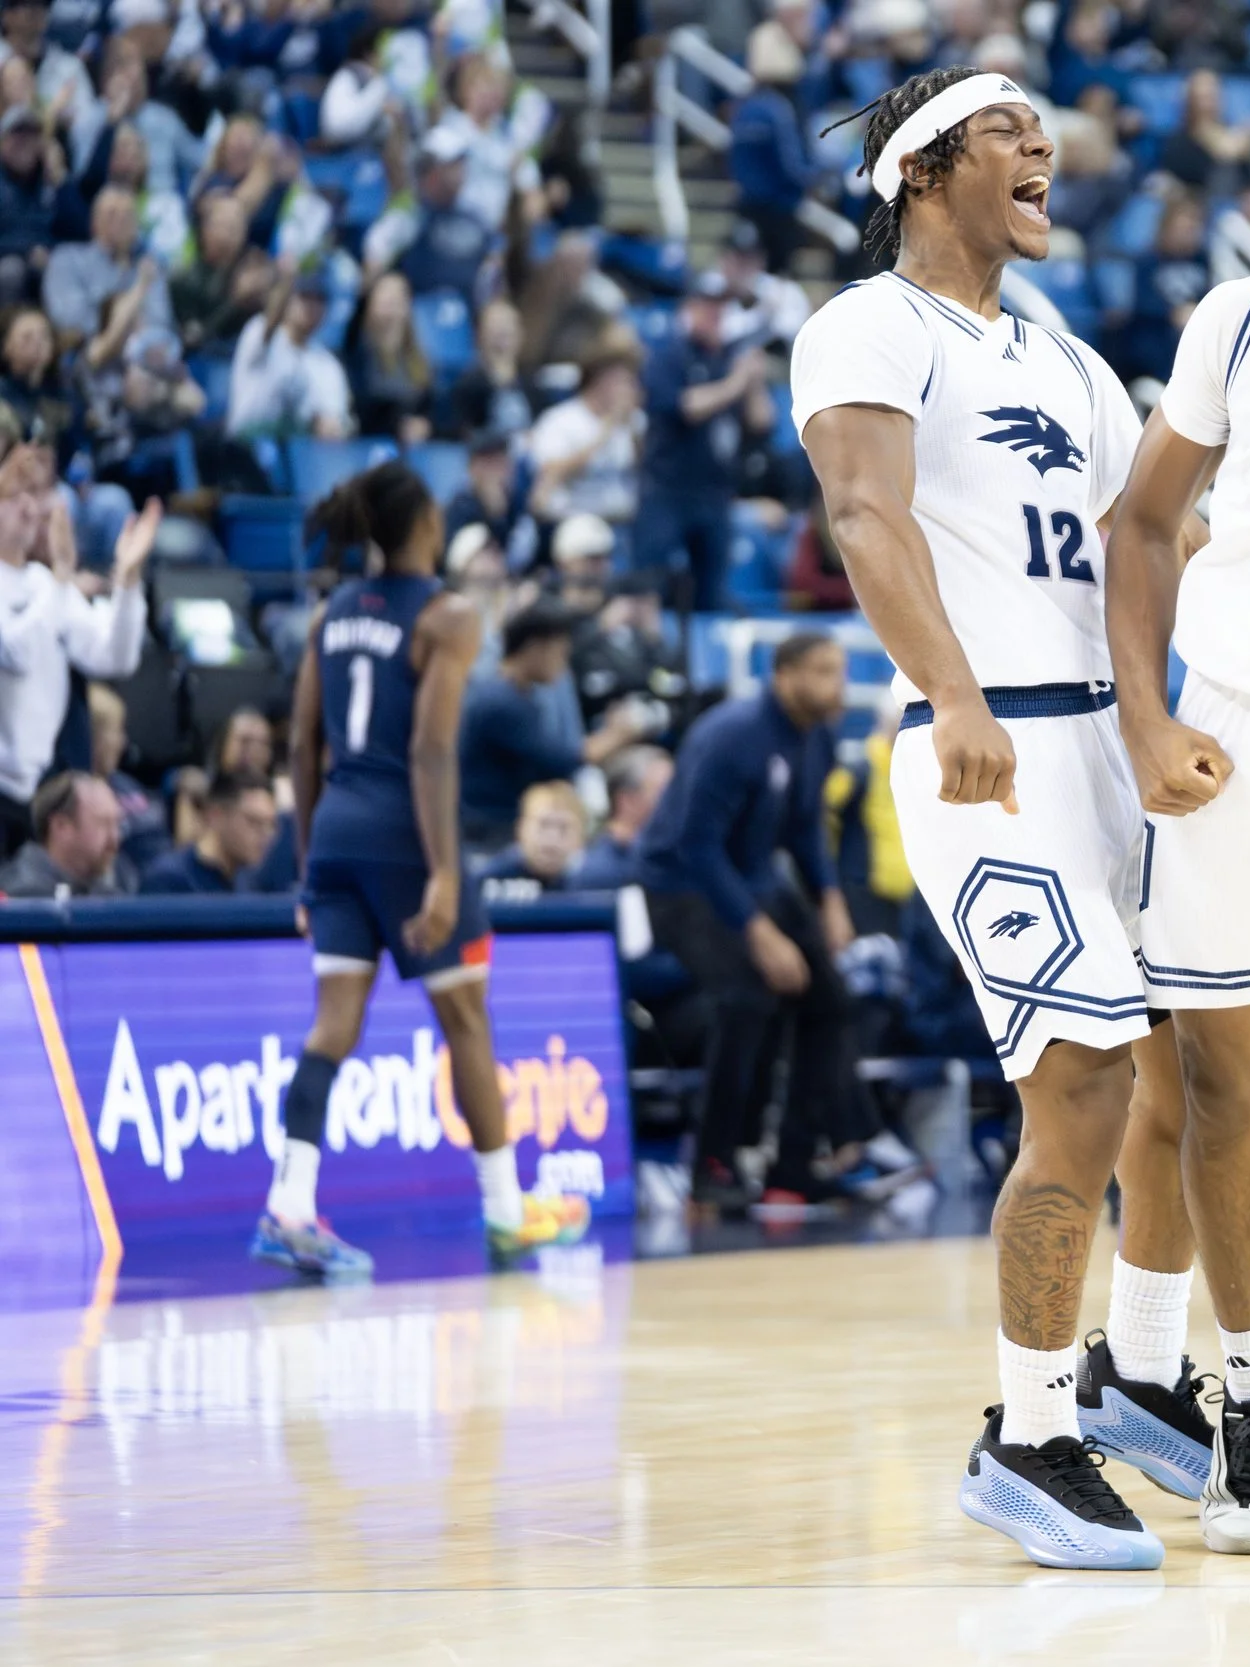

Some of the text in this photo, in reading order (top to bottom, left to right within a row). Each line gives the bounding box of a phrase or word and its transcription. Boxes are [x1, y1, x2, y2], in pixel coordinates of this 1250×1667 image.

[1019, 501, 1097, 587] 12
[346, 654, 373, 754] 1
[97, 1016, 608, 1181] Apartentnie
